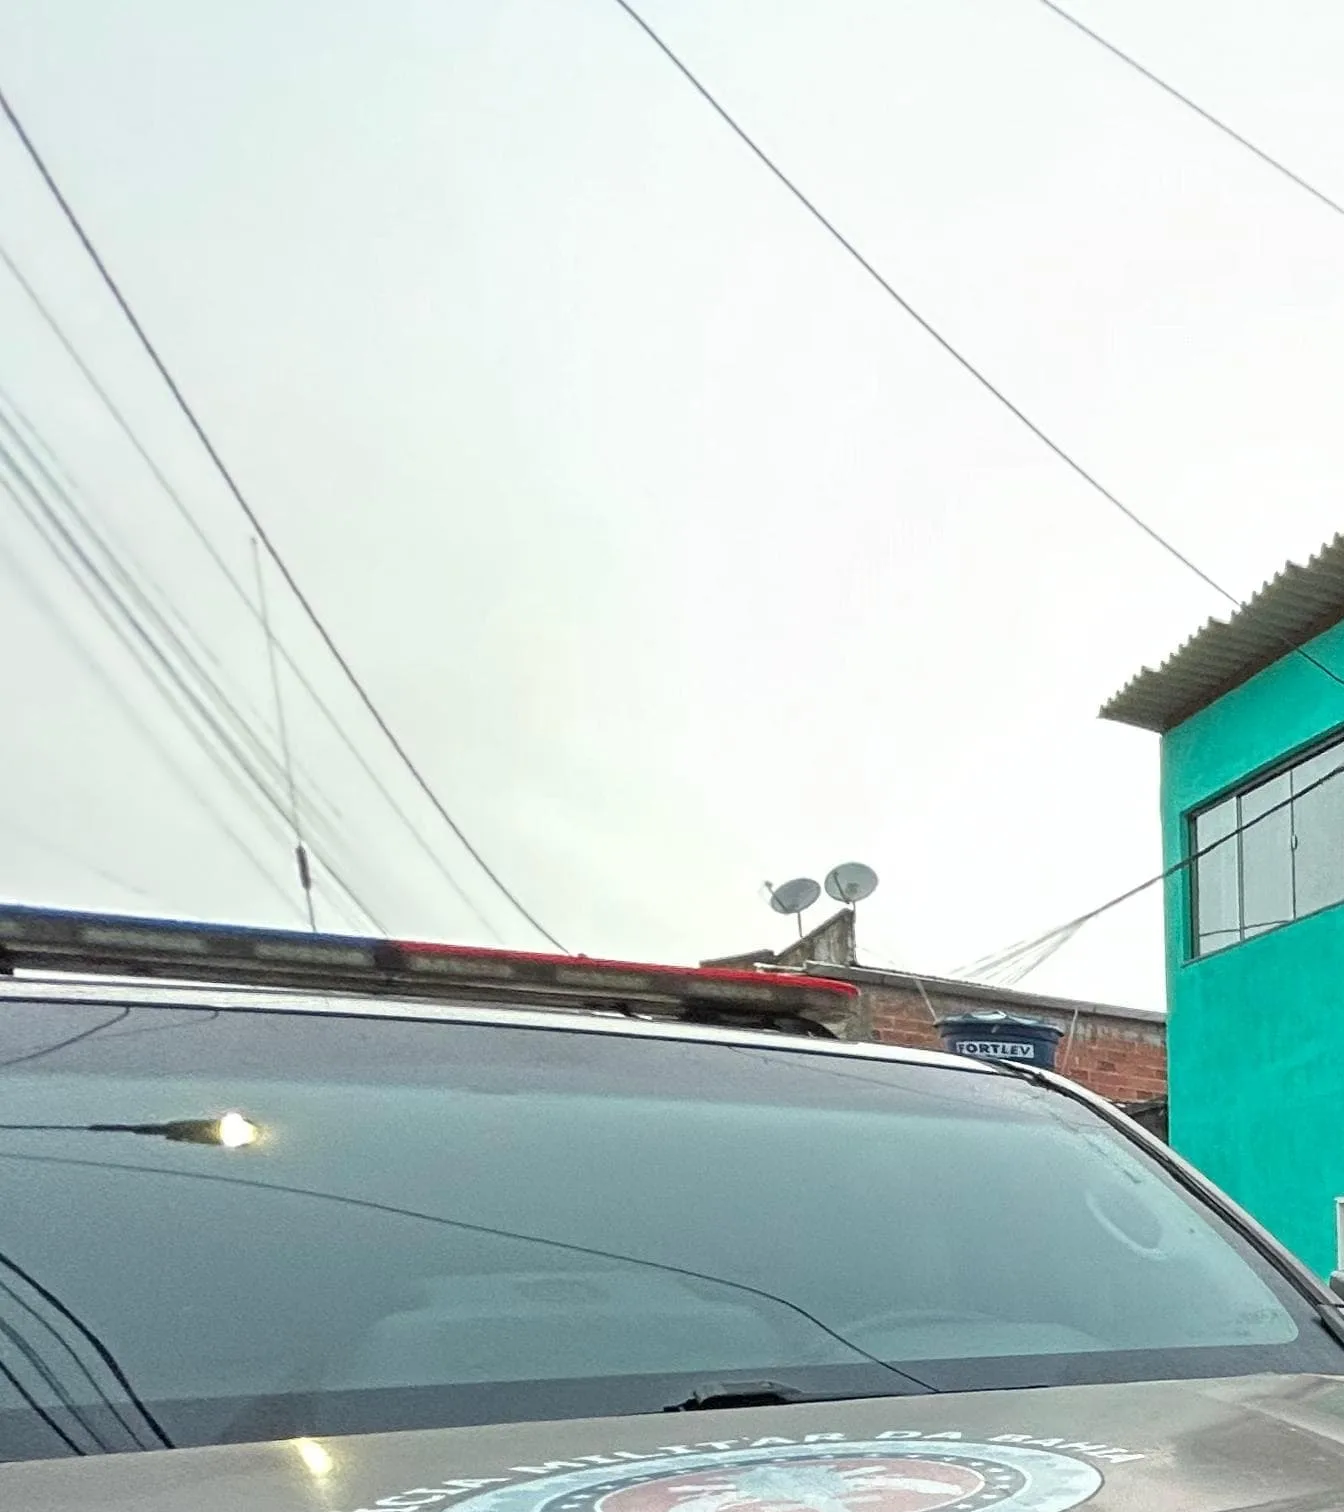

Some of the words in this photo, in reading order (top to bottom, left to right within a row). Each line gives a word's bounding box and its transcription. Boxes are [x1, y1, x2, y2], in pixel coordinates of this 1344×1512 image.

[959, 1043, 1031, 1056] FORTLEV
[508, 1432, 846, 1474] MILITAR
[875, 1430, 962, 1440] DA
[988, 1433, 1145, 1464] BAHIA
